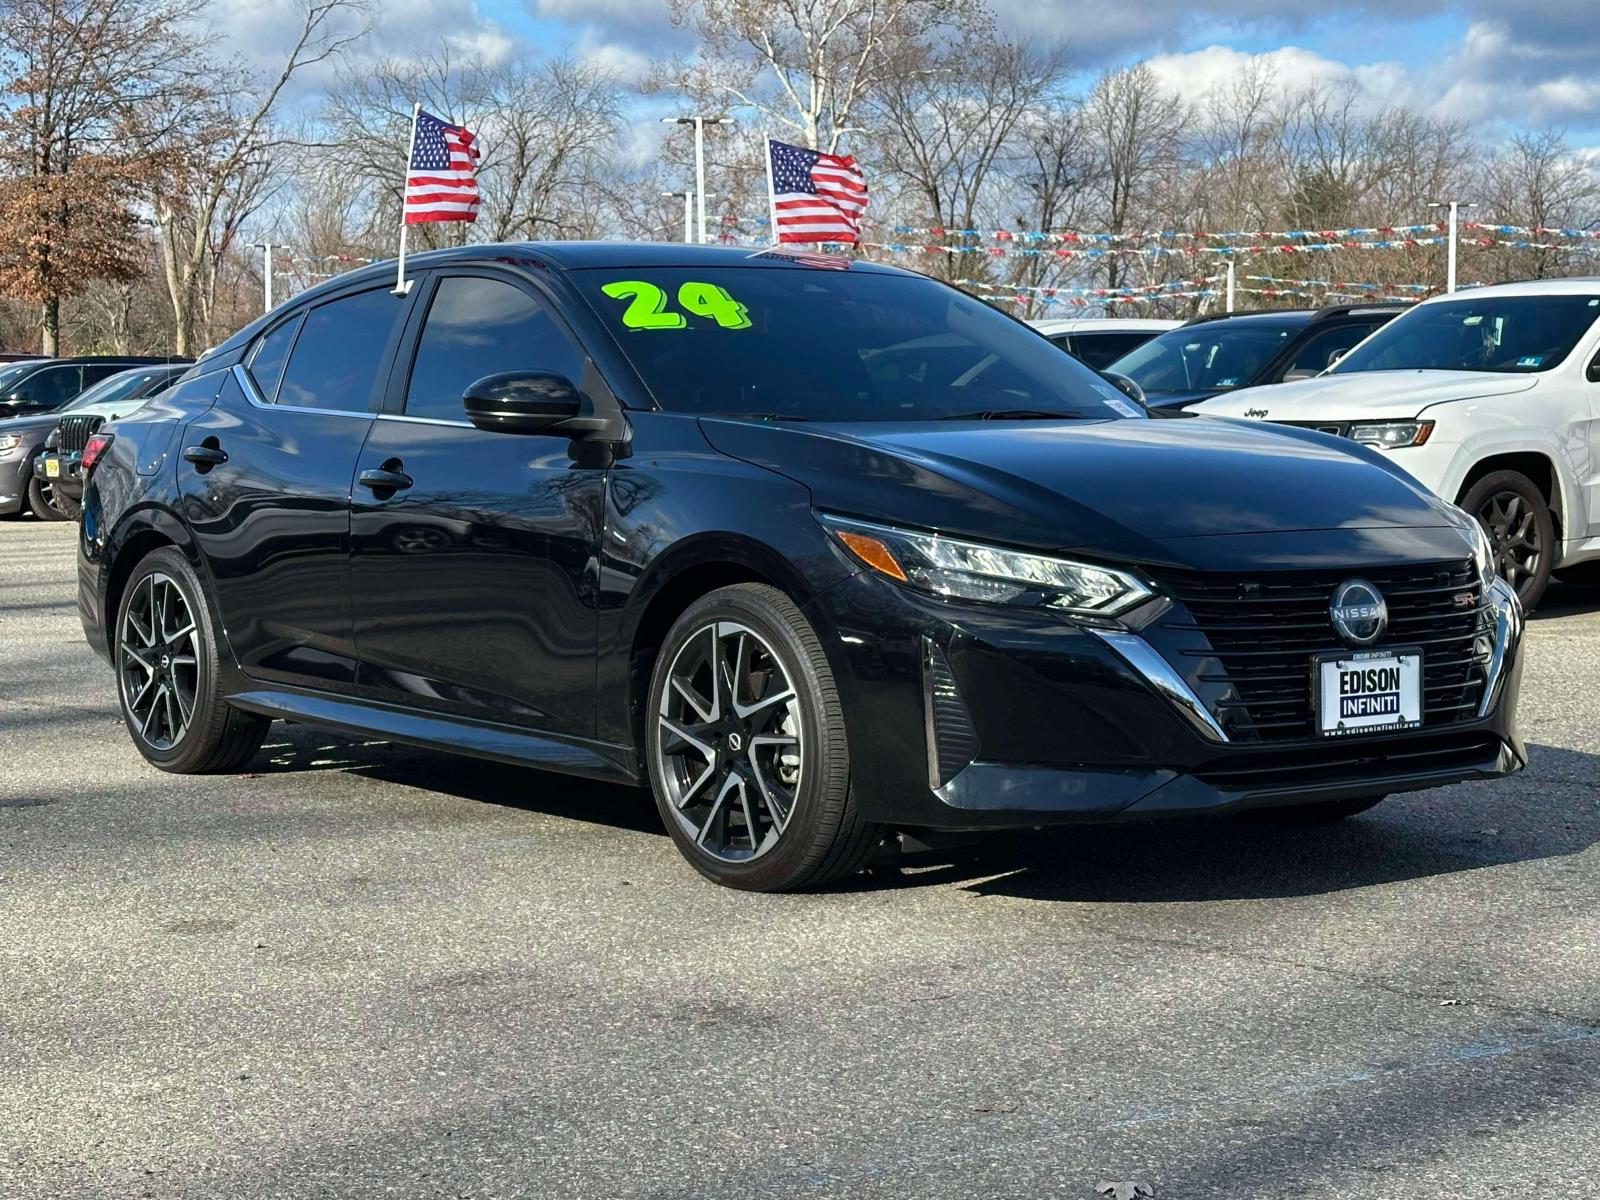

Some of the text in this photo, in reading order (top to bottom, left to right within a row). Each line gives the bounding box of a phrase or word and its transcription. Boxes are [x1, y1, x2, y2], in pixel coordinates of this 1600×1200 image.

[601, 280, 753, 330] 24
[1244, 408, 1269, 419] Jeep
[1455, 593, 1475, 606] SR
[1334, 607, 1386, 619] NISSAN
[1340, 667, 1400, 695] EDISON
[1343, 696, 1398, 715] INFINITI
[1324, 722, 1421, 737] www.edisoninfiniti.com
